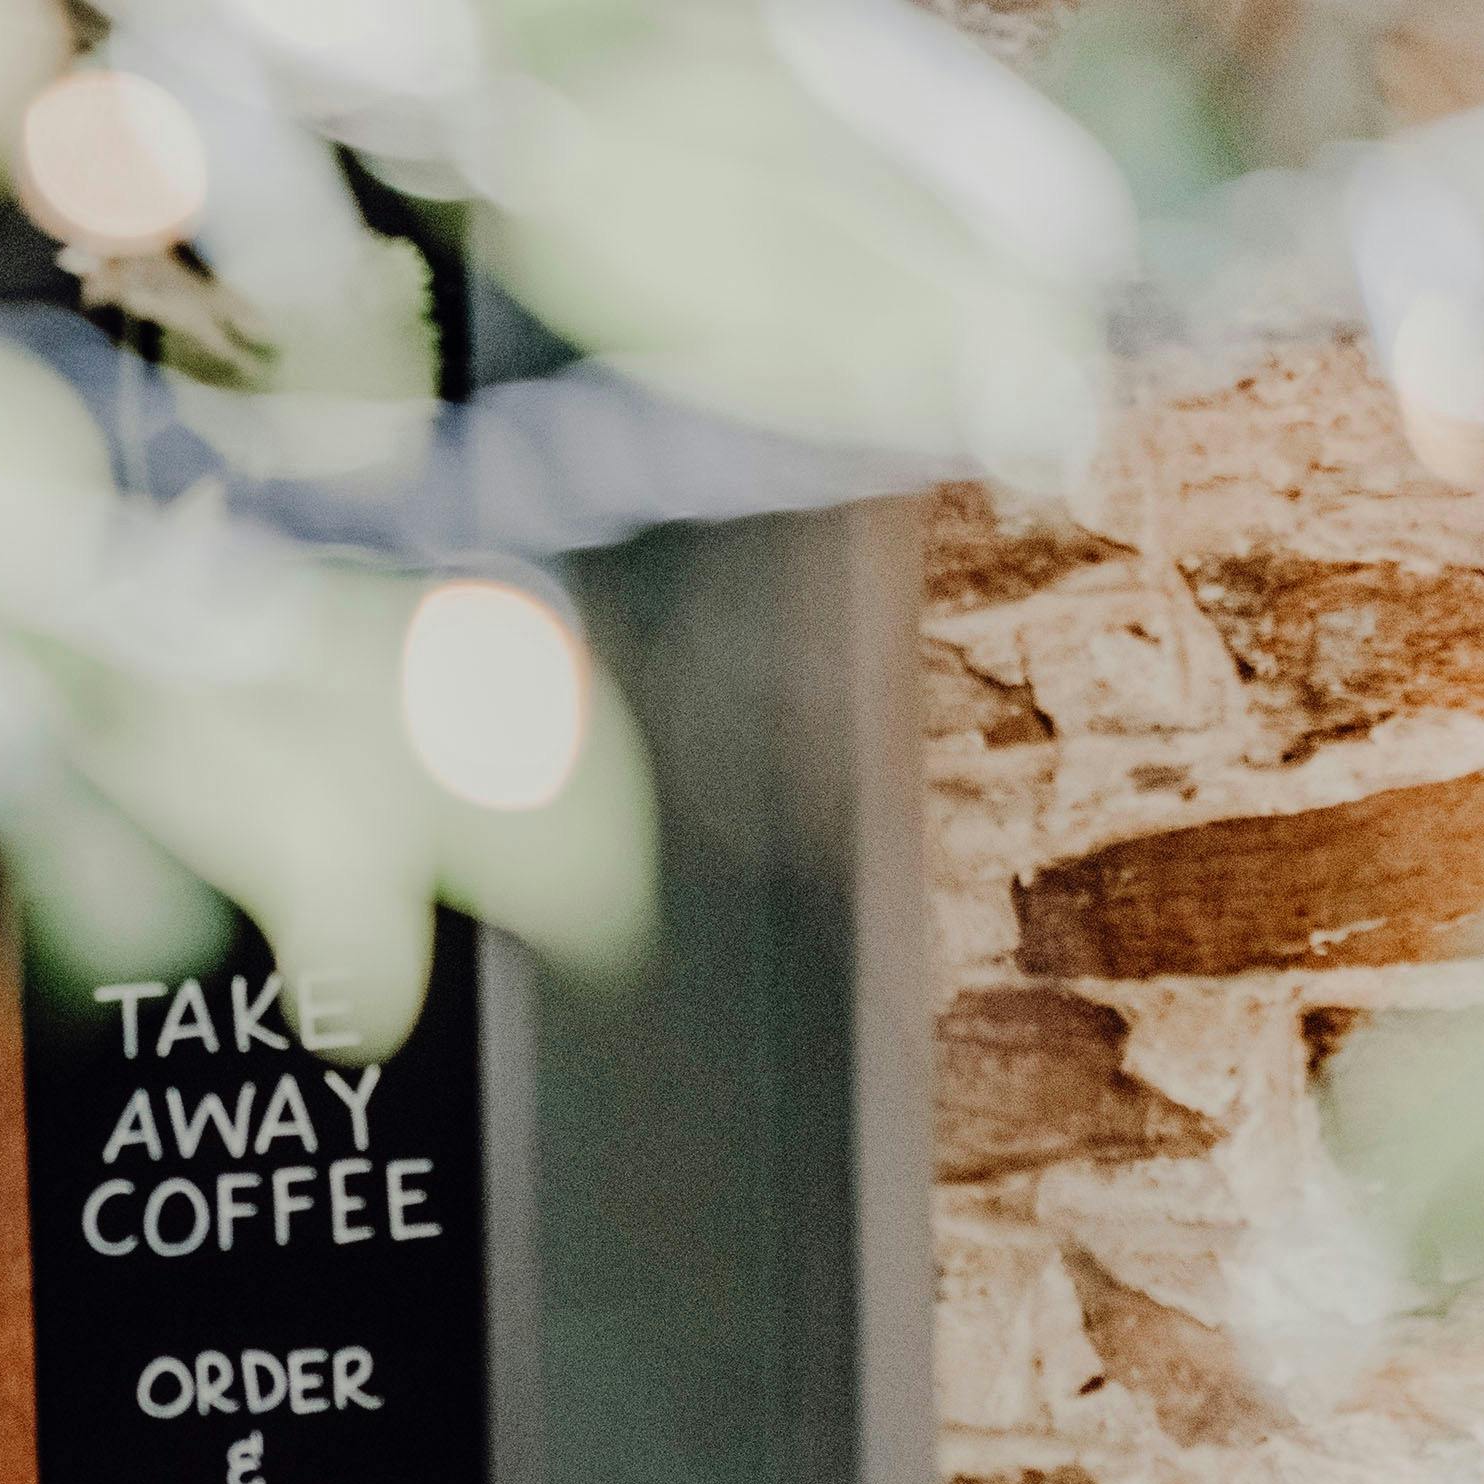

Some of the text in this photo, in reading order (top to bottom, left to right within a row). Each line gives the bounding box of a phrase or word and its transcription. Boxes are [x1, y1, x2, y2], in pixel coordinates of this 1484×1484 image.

[93, 973, 362, 1060] TAKE
[101, 1064, 383, 1164] AWAY
[81, 1157, 442, 1258] COFFEE
[135, 1345, 383, 1420] ORDER
